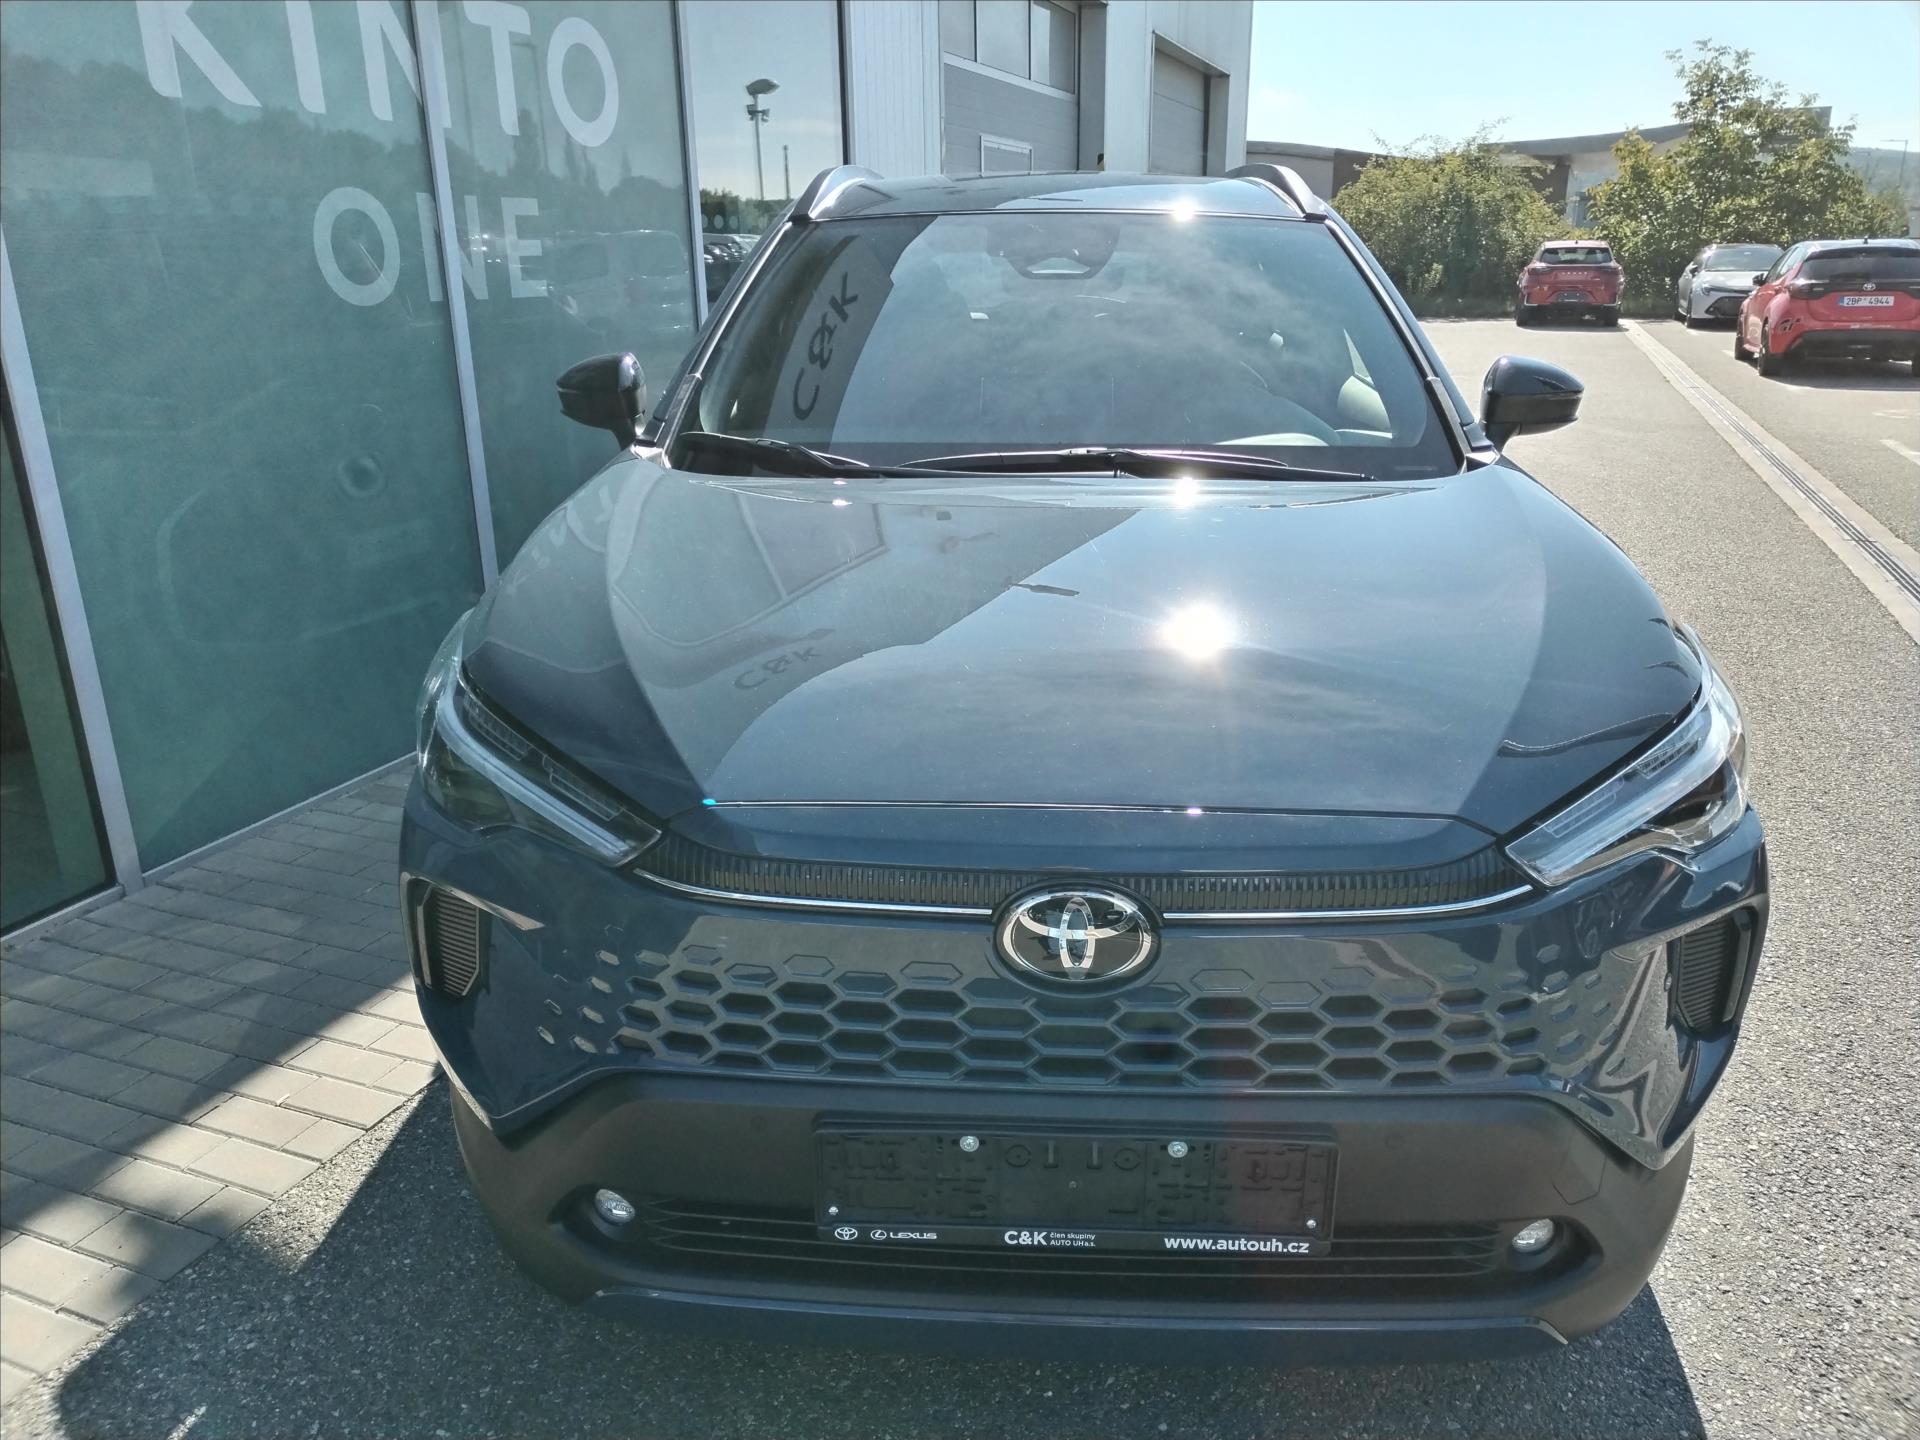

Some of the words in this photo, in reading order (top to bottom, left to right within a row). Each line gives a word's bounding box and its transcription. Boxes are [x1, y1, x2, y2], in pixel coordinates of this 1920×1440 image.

[136, 0, 619, 147] KINTO
[313, 187, 548, 307] ONE
[1868, 297, 1890, 305] 4944
[890, 1232, 938, 1240] LEXUS
[1004, 1230, 1047, 1245] C&K
[1067, 1232, 1096, 1240] skupiny
[1164, 1237, 1310, 1253] www.autouh.cz
